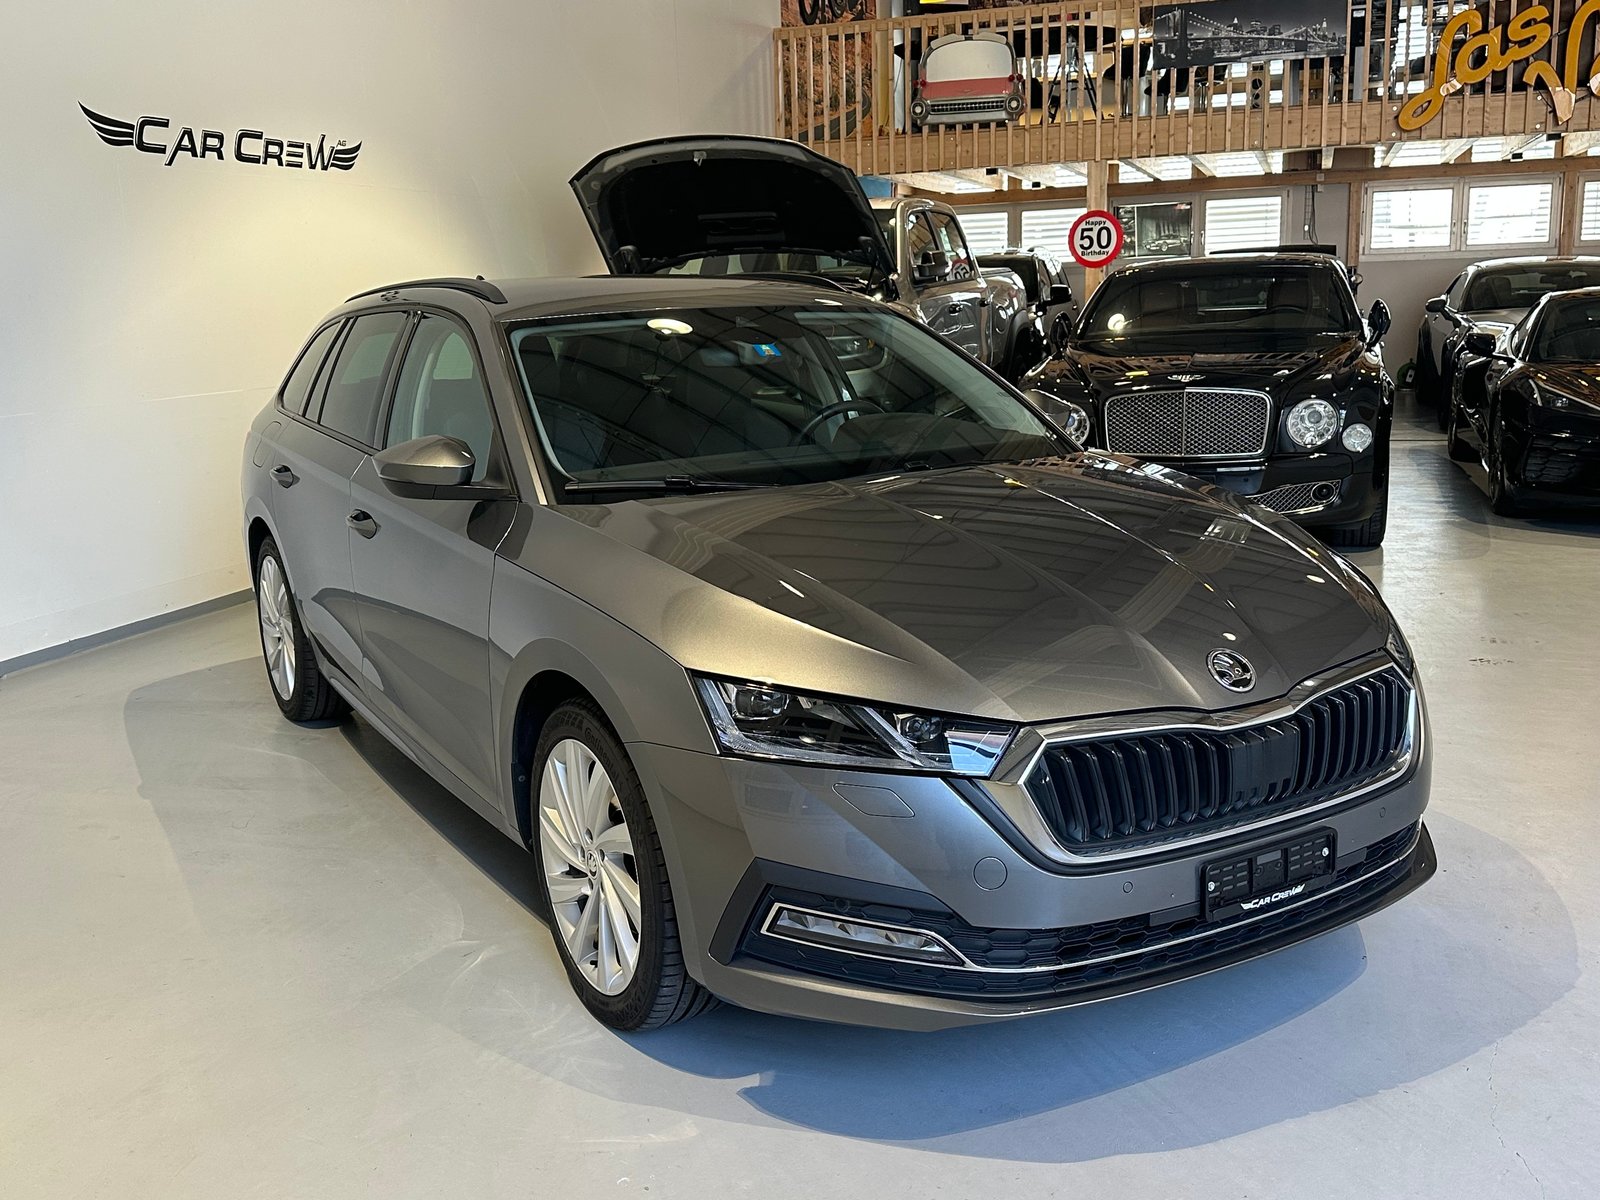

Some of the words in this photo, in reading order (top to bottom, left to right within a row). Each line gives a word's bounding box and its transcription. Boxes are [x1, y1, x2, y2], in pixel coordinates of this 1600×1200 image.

[1397, 4, 1552, 131] Las
[1523, 0, 1600, 126] V
[134, 115, 225, 167] CAR
[234, 128, 336, 171] CREW
[1079, 226, 1112, 251] 50
[1081, 249, 1110, 257] Birthday
[1251, 897, 1271, 909] CAR
